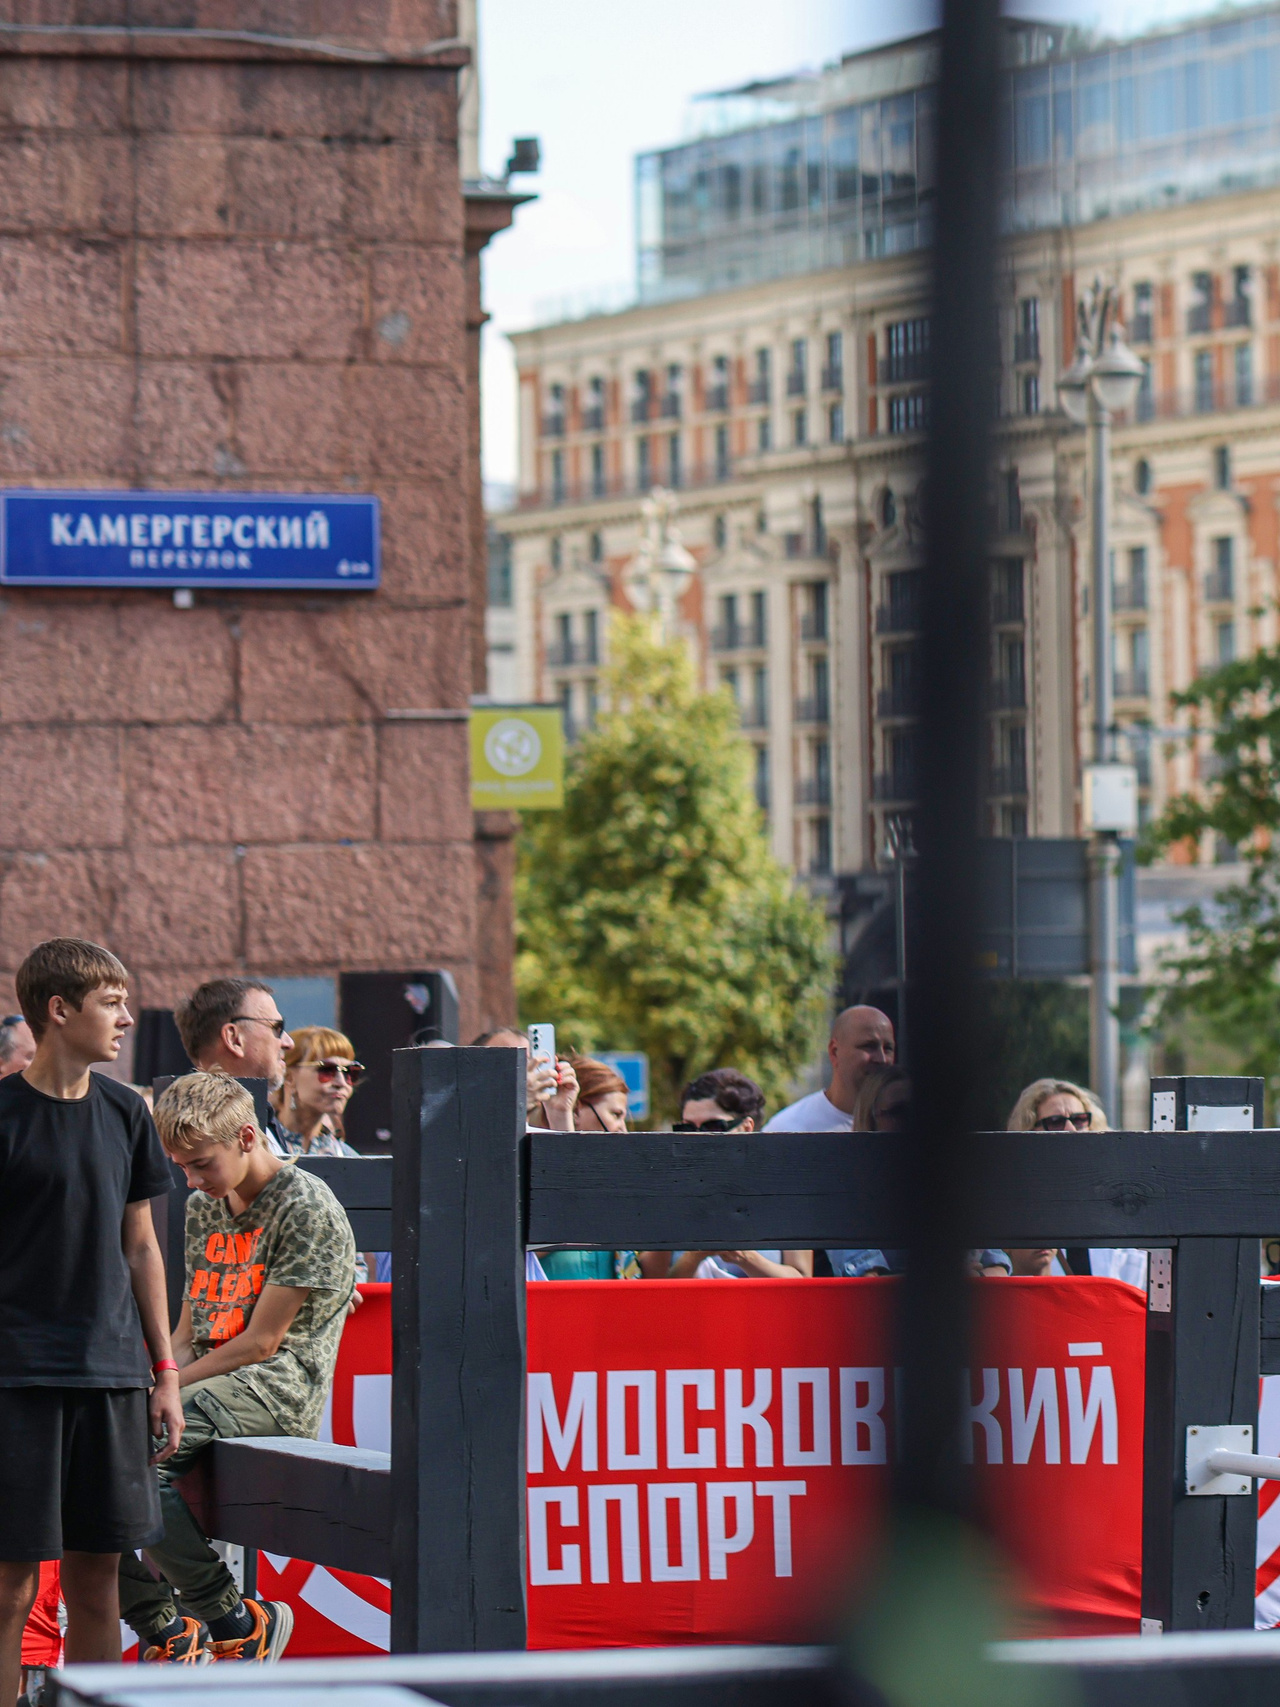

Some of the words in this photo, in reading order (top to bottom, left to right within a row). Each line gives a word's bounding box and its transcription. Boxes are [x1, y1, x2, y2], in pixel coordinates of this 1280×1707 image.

[51, 511, 330, 549] КАМЕРГЕРСКИЙ
[129, 549, 252, 569] ПЕРЕУЛОК
[526, 1342, 1119, 1474] МОСКОВКИЙ
[527, 1480, 807, 1586] СПОРТ
